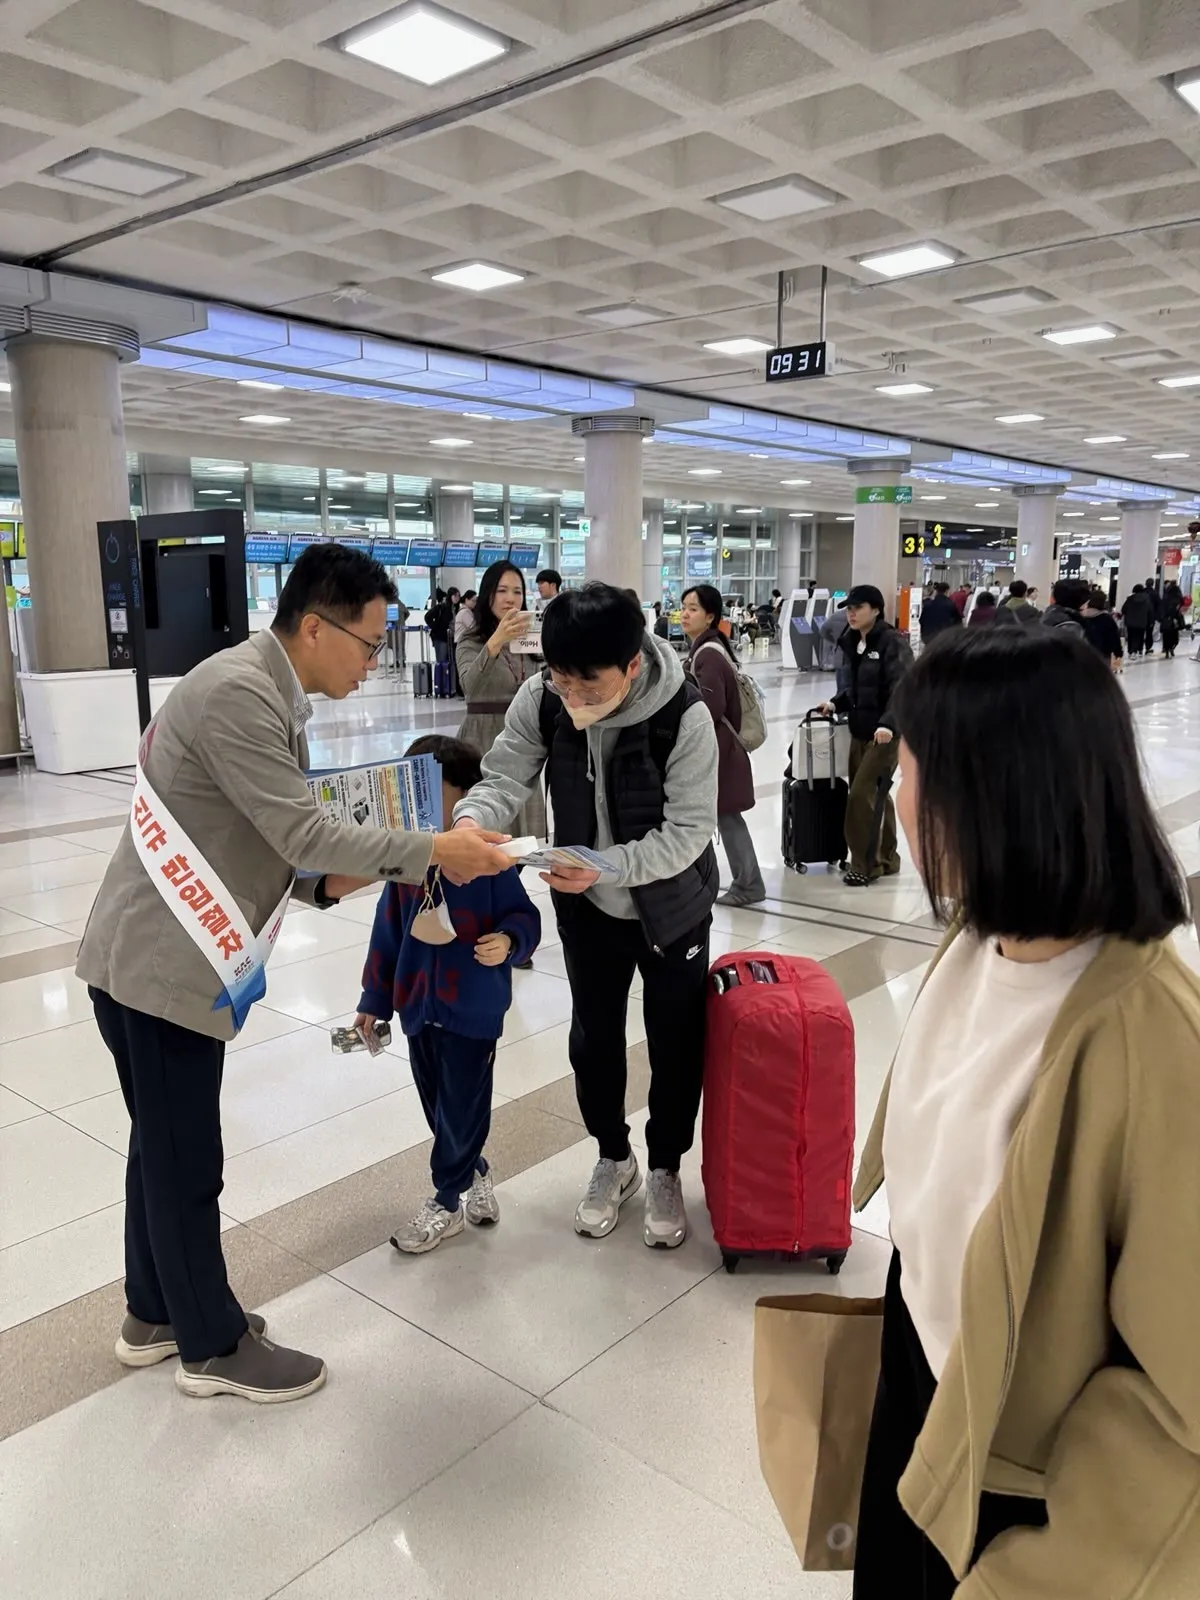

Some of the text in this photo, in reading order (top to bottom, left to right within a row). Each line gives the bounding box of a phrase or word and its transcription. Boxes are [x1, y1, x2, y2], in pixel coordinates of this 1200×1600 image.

[769, 349, 822, 375] 09 31
[904, 536, 915, 554] 3
[918, 536, 925, 554] 3
[933, 524, 942, 547] 3
[133, 795, 244, 961] 신규 반입절차
